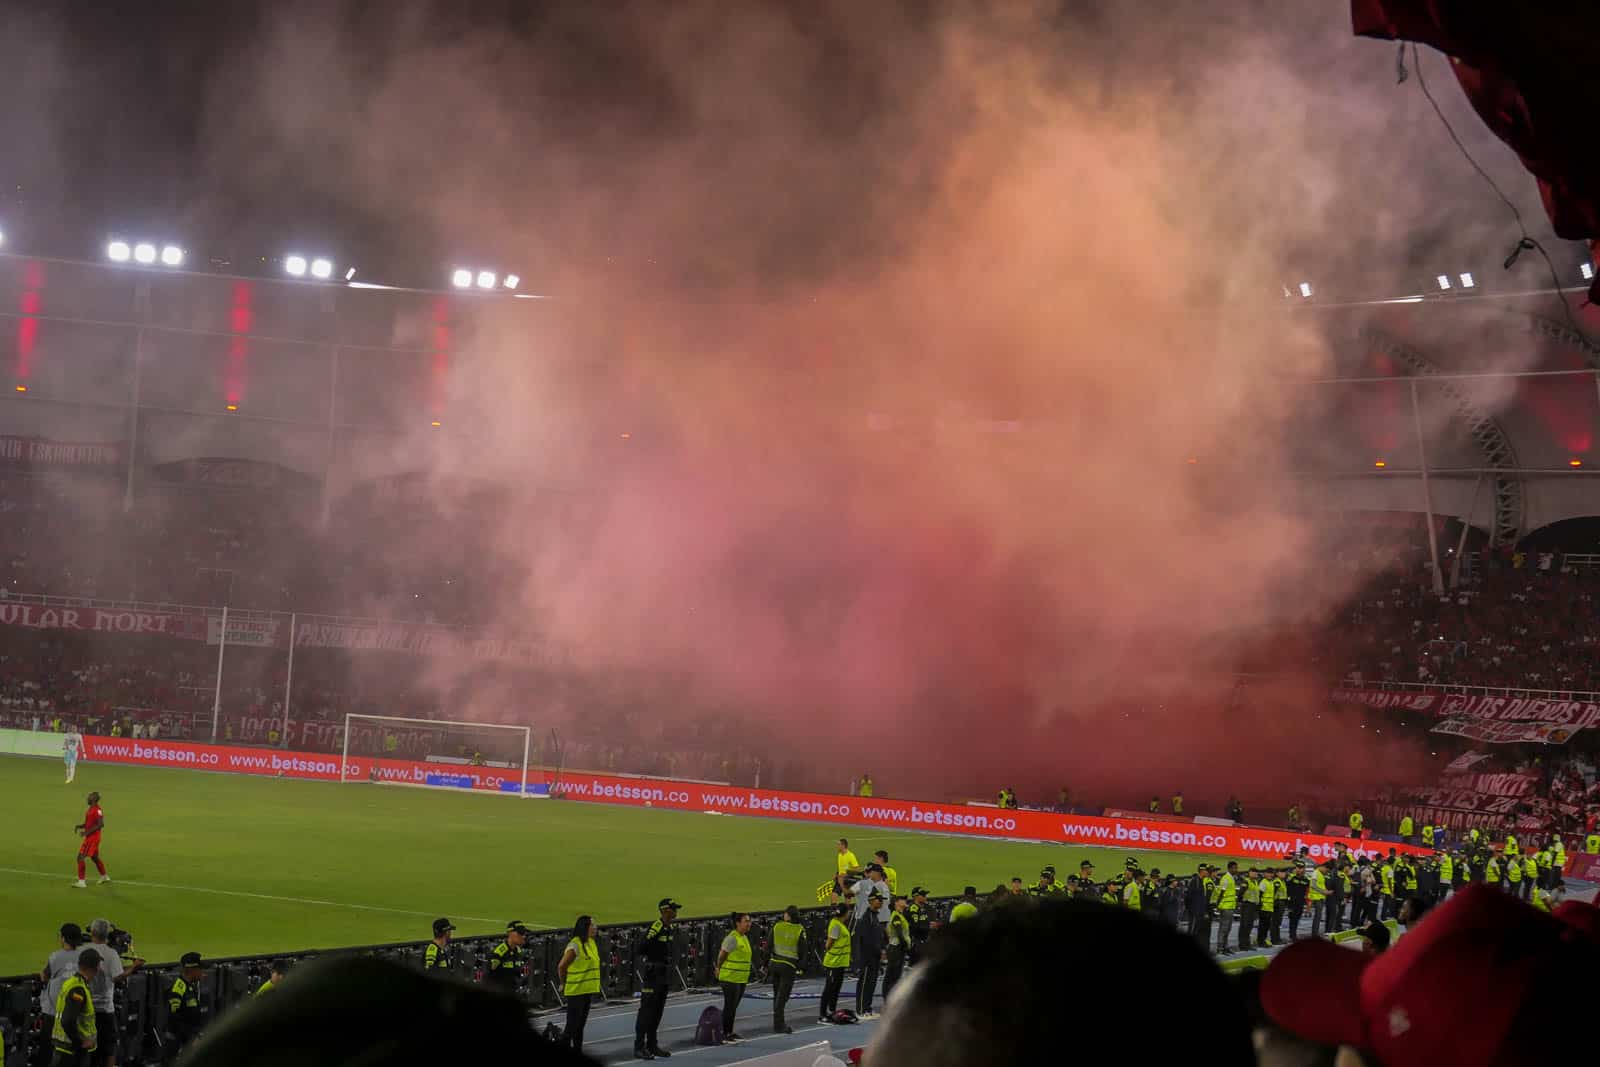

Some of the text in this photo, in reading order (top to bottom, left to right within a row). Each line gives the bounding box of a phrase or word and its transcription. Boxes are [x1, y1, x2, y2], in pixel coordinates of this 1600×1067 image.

[1464, 696, 1505, 720] LOS
[93, 744, 219, 764] www.betsson.co
[230, 753, 360, 776] www.betsson.co
[547, 780, 689, 803] www.betsson.co
[703, 793, 850, 817] www.betsson.co
[862, 802, 1016, 831] www.betsson.co
[1063, 823, 1226, 848] www.betsson.co
